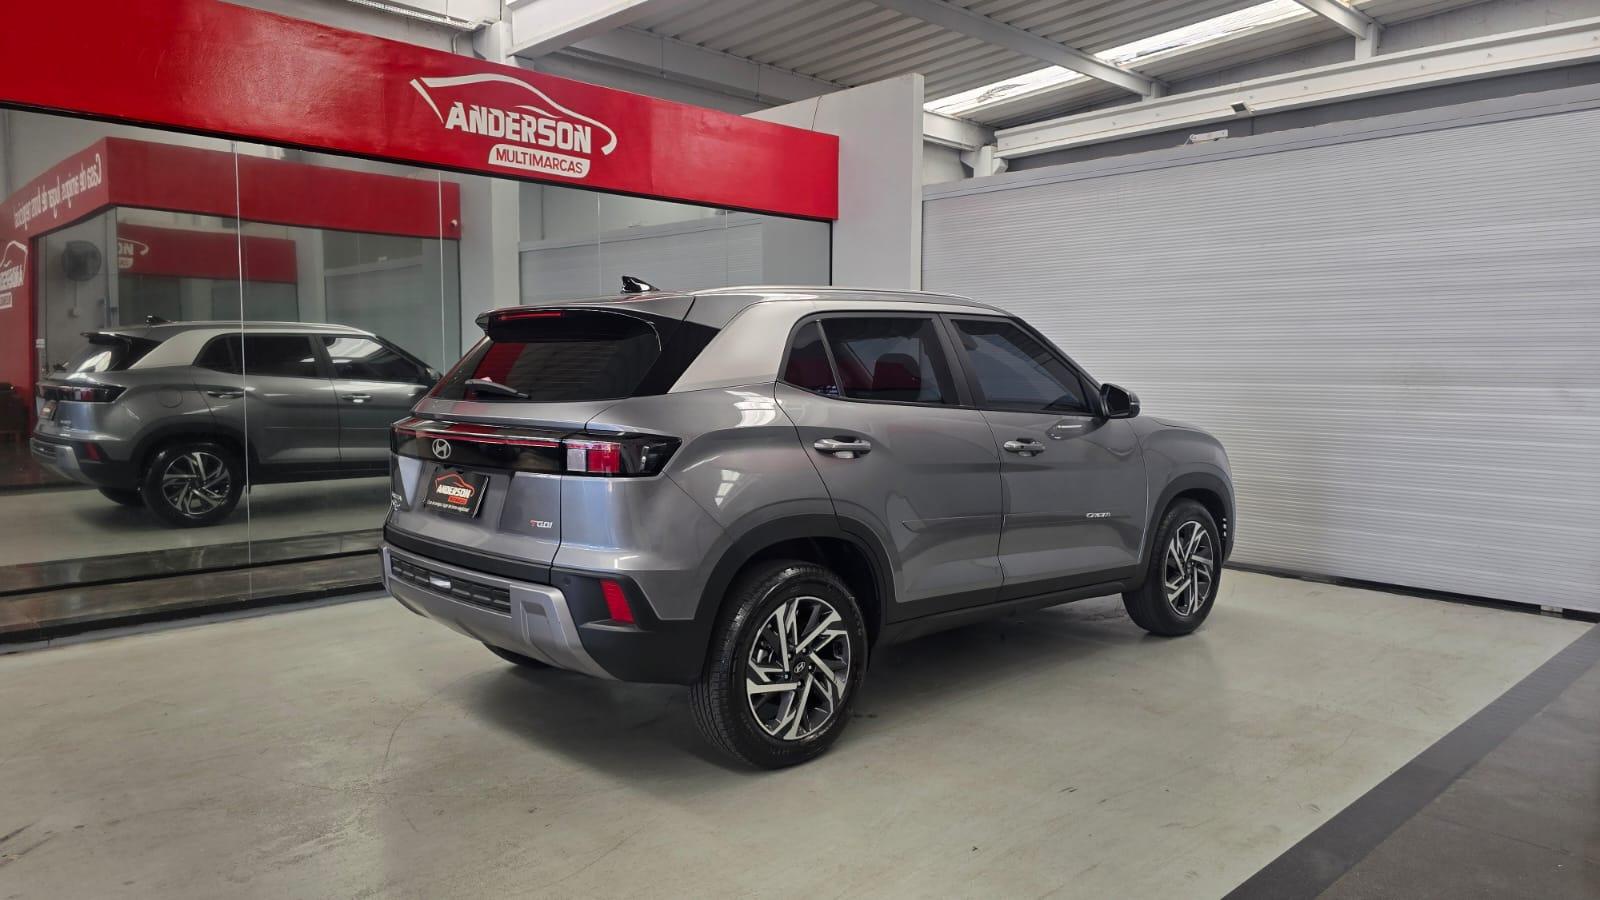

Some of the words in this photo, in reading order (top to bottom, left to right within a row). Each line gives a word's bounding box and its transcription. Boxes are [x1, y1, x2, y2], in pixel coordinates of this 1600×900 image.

[445, 101, 592, 154] ANDERSON
[496, 147, 583, 174] MULTIMARCAS
[436, 484, 472, 499] ANDERSON
